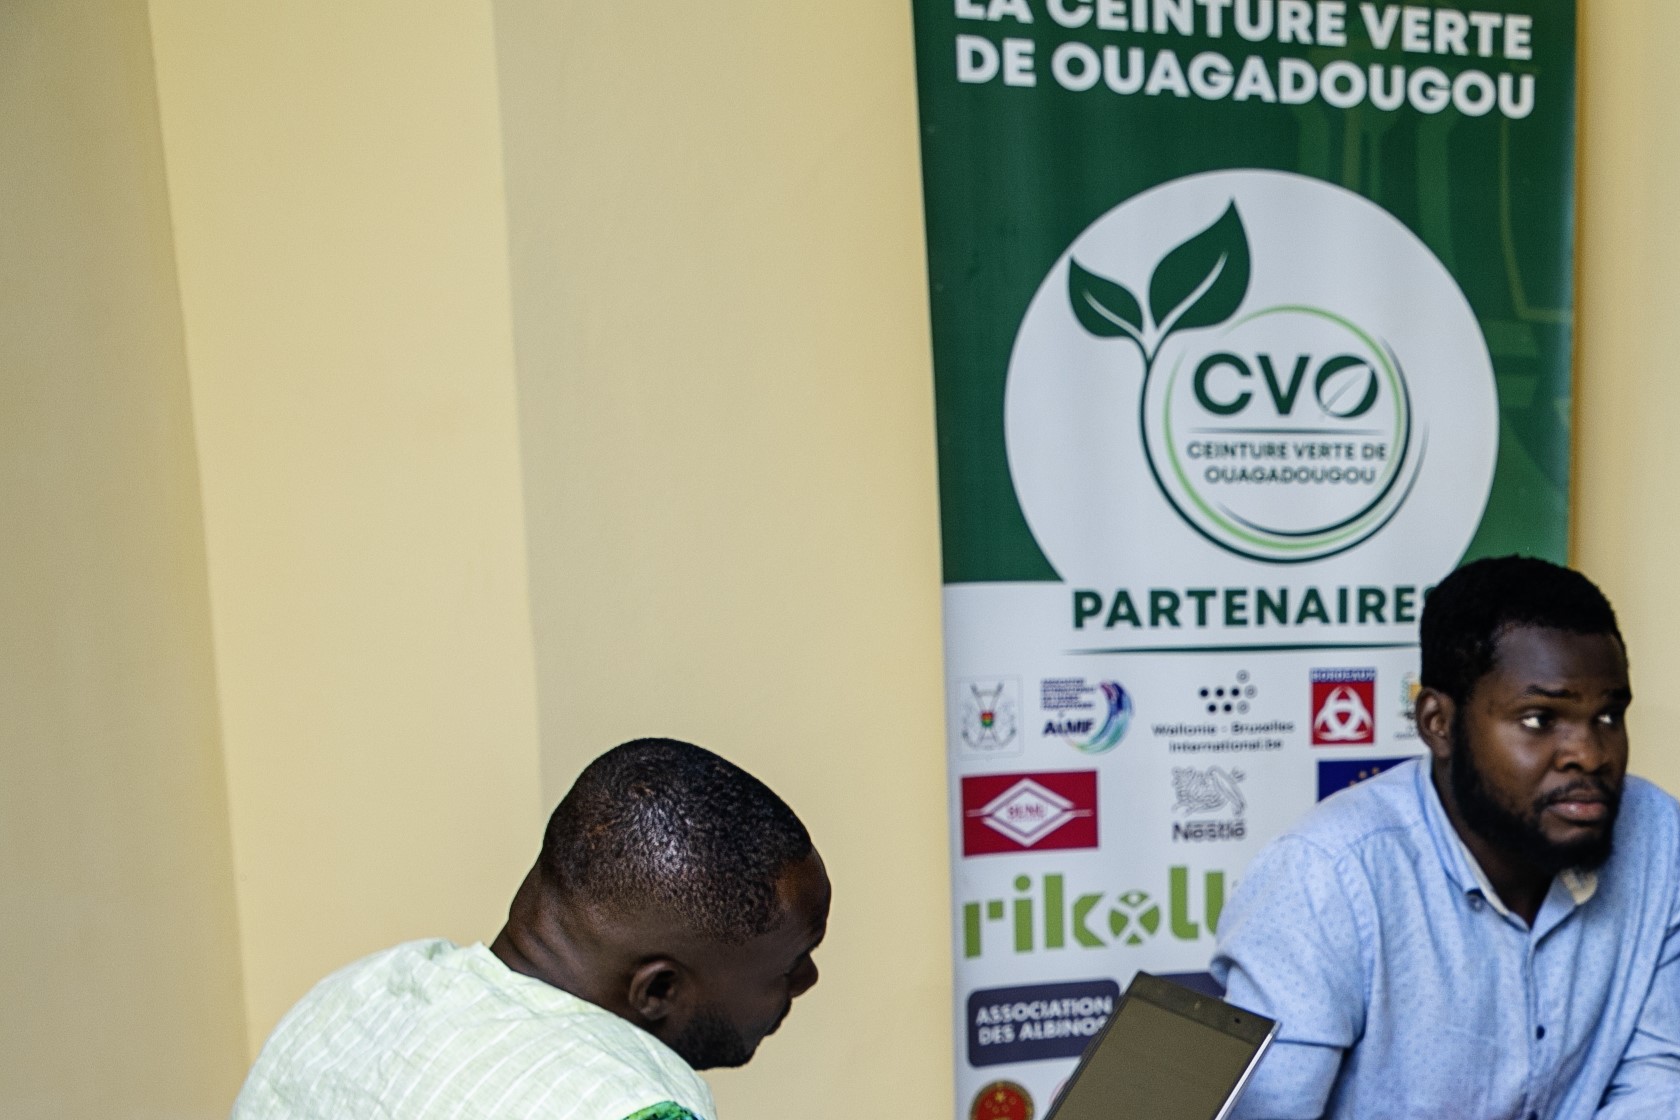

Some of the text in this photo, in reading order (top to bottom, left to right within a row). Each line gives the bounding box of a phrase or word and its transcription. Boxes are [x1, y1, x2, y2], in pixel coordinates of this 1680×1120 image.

[1045, 0, 1347, 47] CEINTURE
[1359, 2, 1533, 61] VERTE
[955, 33, 1536, 120] DE OUAGADOUGOU
[1192, 352, 1379, 418] CVO
[1186, 440, 1388, 461] CEINTURE VERTE DE
[1204, 464, 1377, 485] OUAGADOUGOU
[1072, 584, 1436, 630] PARTENAIRE
[1152, 723, 1217, 736] Wallonie
[1231, 720, 1296, 735] Bruxelles
[975, 995, 1113, 1027] ASSOCIATION
[977, 1022, 1016, 1046] DES
